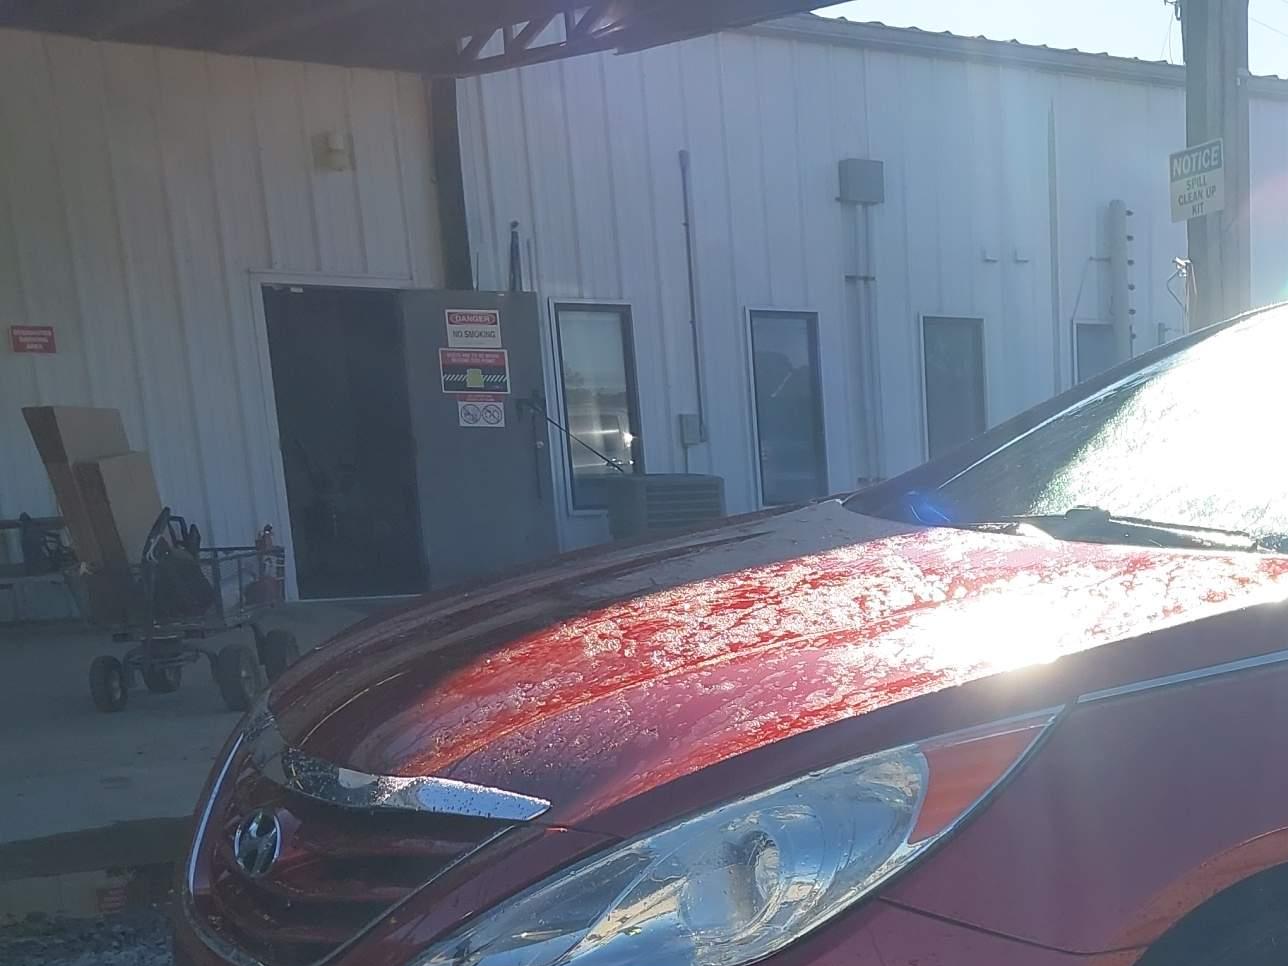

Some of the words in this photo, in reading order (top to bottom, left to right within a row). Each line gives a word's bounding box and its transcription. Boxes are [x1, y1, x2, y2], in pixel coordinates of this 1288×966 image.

[1173, 145, 1220, 177] NOTICE
[1186, 175, 1207, 191] SPILL
[1178, 189, 1203, 206] CLEAN
[1206, 184, 1217, 199] UP
[1191, 202, 1205, 216] KIT
[453, 330, 463, 338] NO
[464, 330, 496, 338] SMOKING
